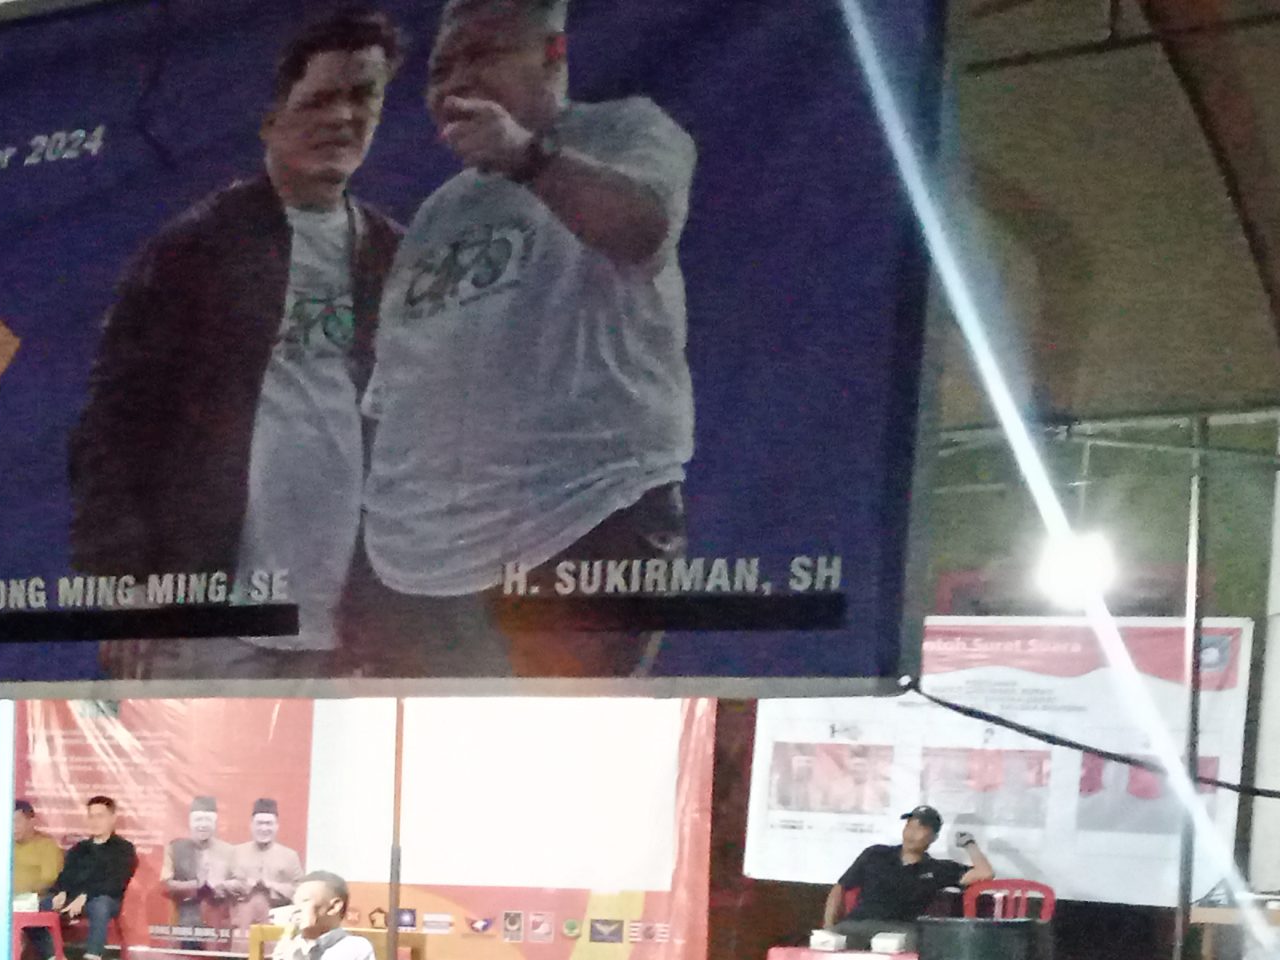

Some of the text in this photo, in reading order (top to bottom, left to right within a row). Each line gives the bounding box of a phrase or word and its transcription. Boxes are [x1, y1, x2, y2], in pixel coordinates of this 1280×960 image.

[23, 125, 106, 168] 2024
[58, 574, 136, 608] MING
[249, 568, 290, 602] SE
[502, 555, 843, 596] H. SUKIRMAN, SH
